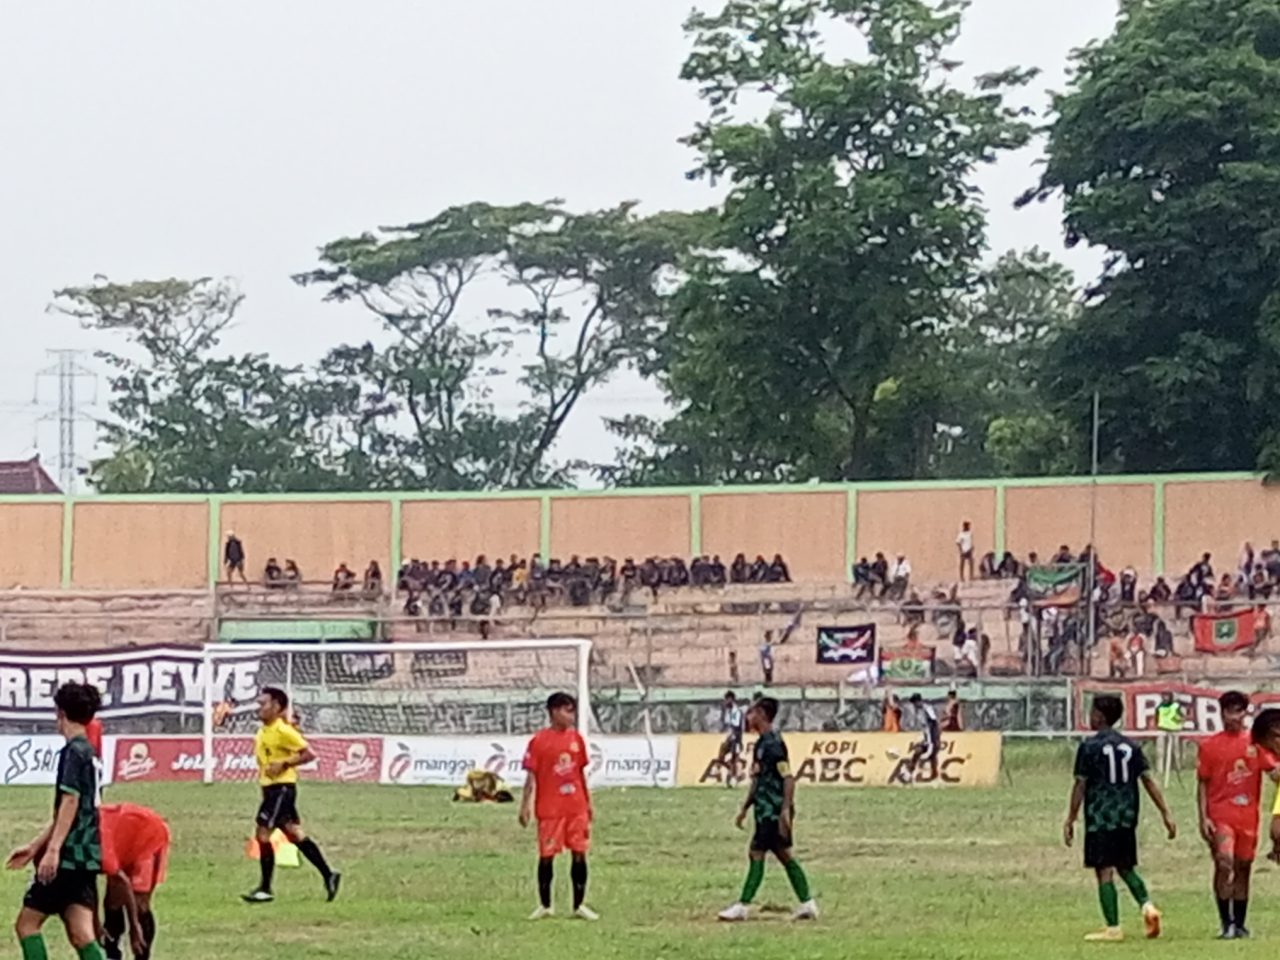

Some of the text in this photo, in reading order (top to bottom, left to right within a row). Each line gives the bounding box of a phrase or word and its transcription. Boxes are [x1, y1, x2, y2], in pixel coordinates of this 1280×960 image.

[122, 661, 260, 702] DEWE
[811, 740, 858, 755] KOPI
[794, 758, 867, 783] ABC
